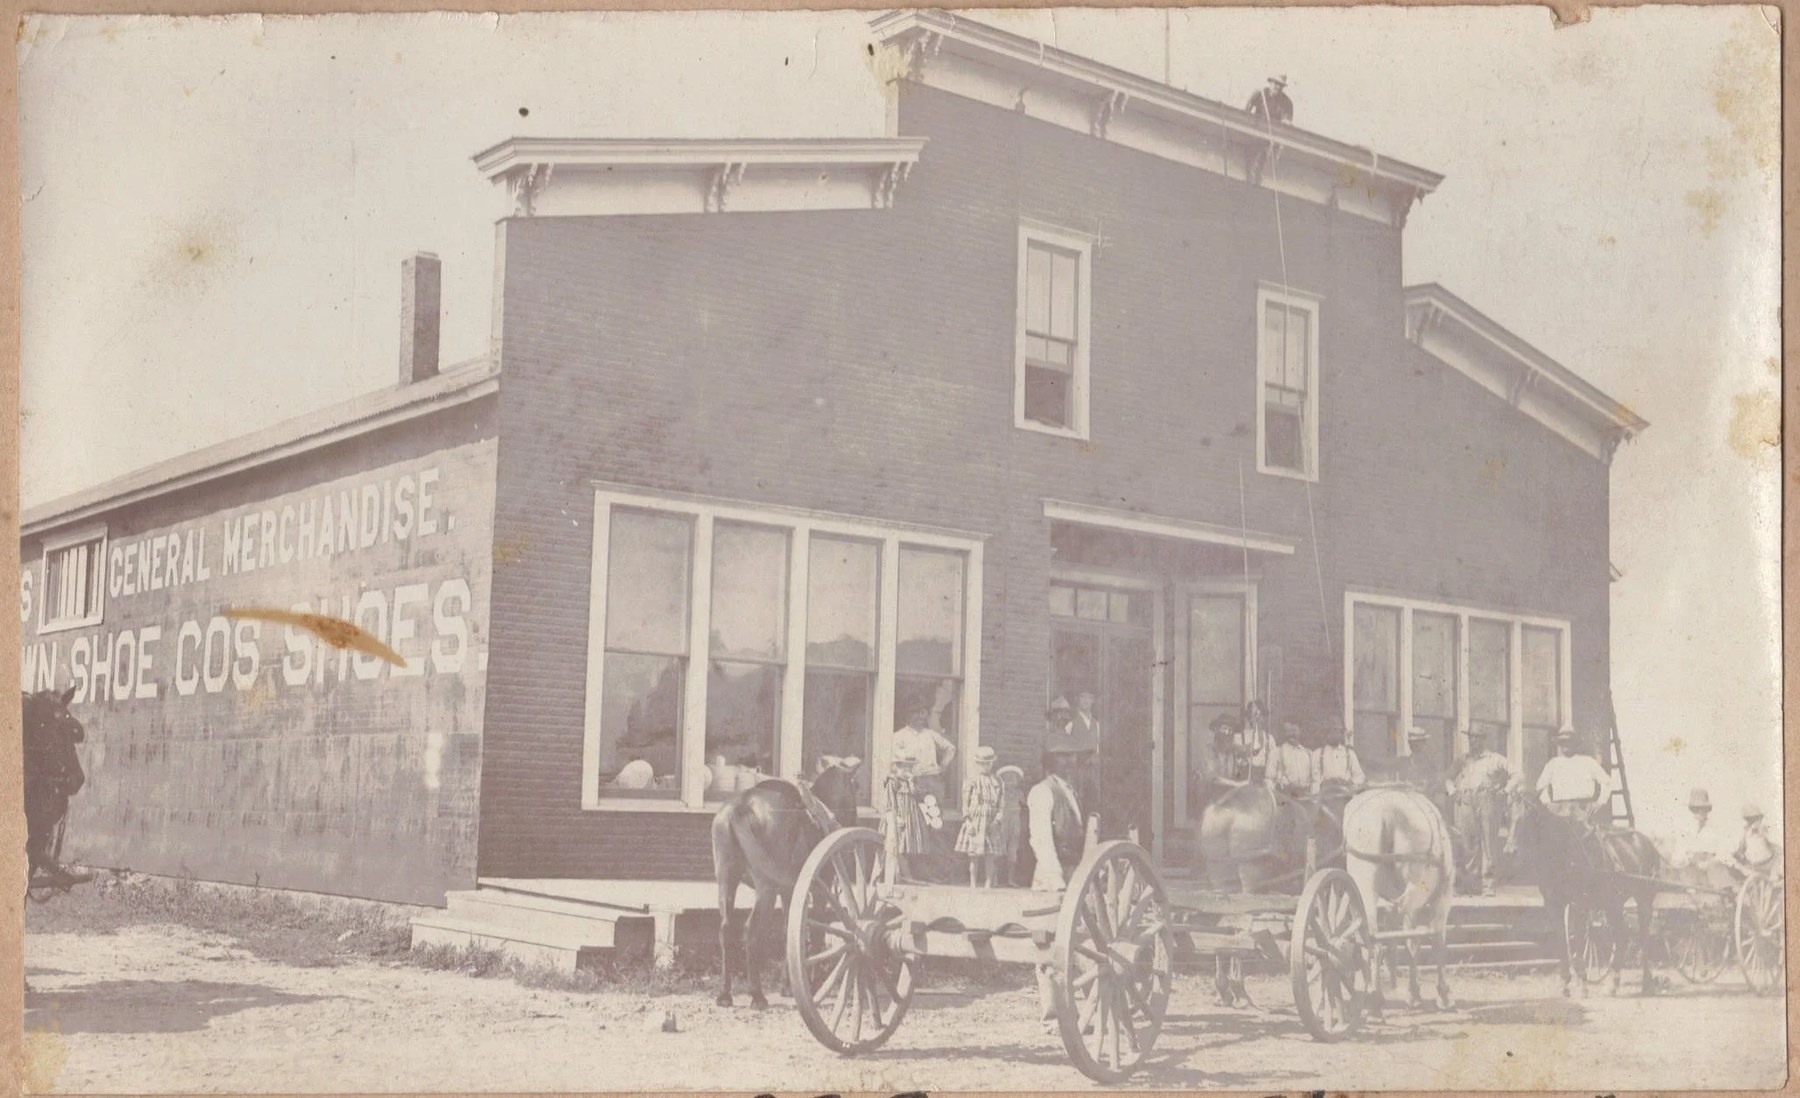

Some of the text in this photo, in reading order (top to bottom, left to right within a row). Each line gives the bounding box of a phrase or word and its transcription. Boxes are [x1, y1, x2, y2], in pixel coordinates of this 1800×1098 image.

[109, 526, 210, 598] GENERAL
[70, 625, 161, 704] SHOE
[175, 616, 261, 696] COS
